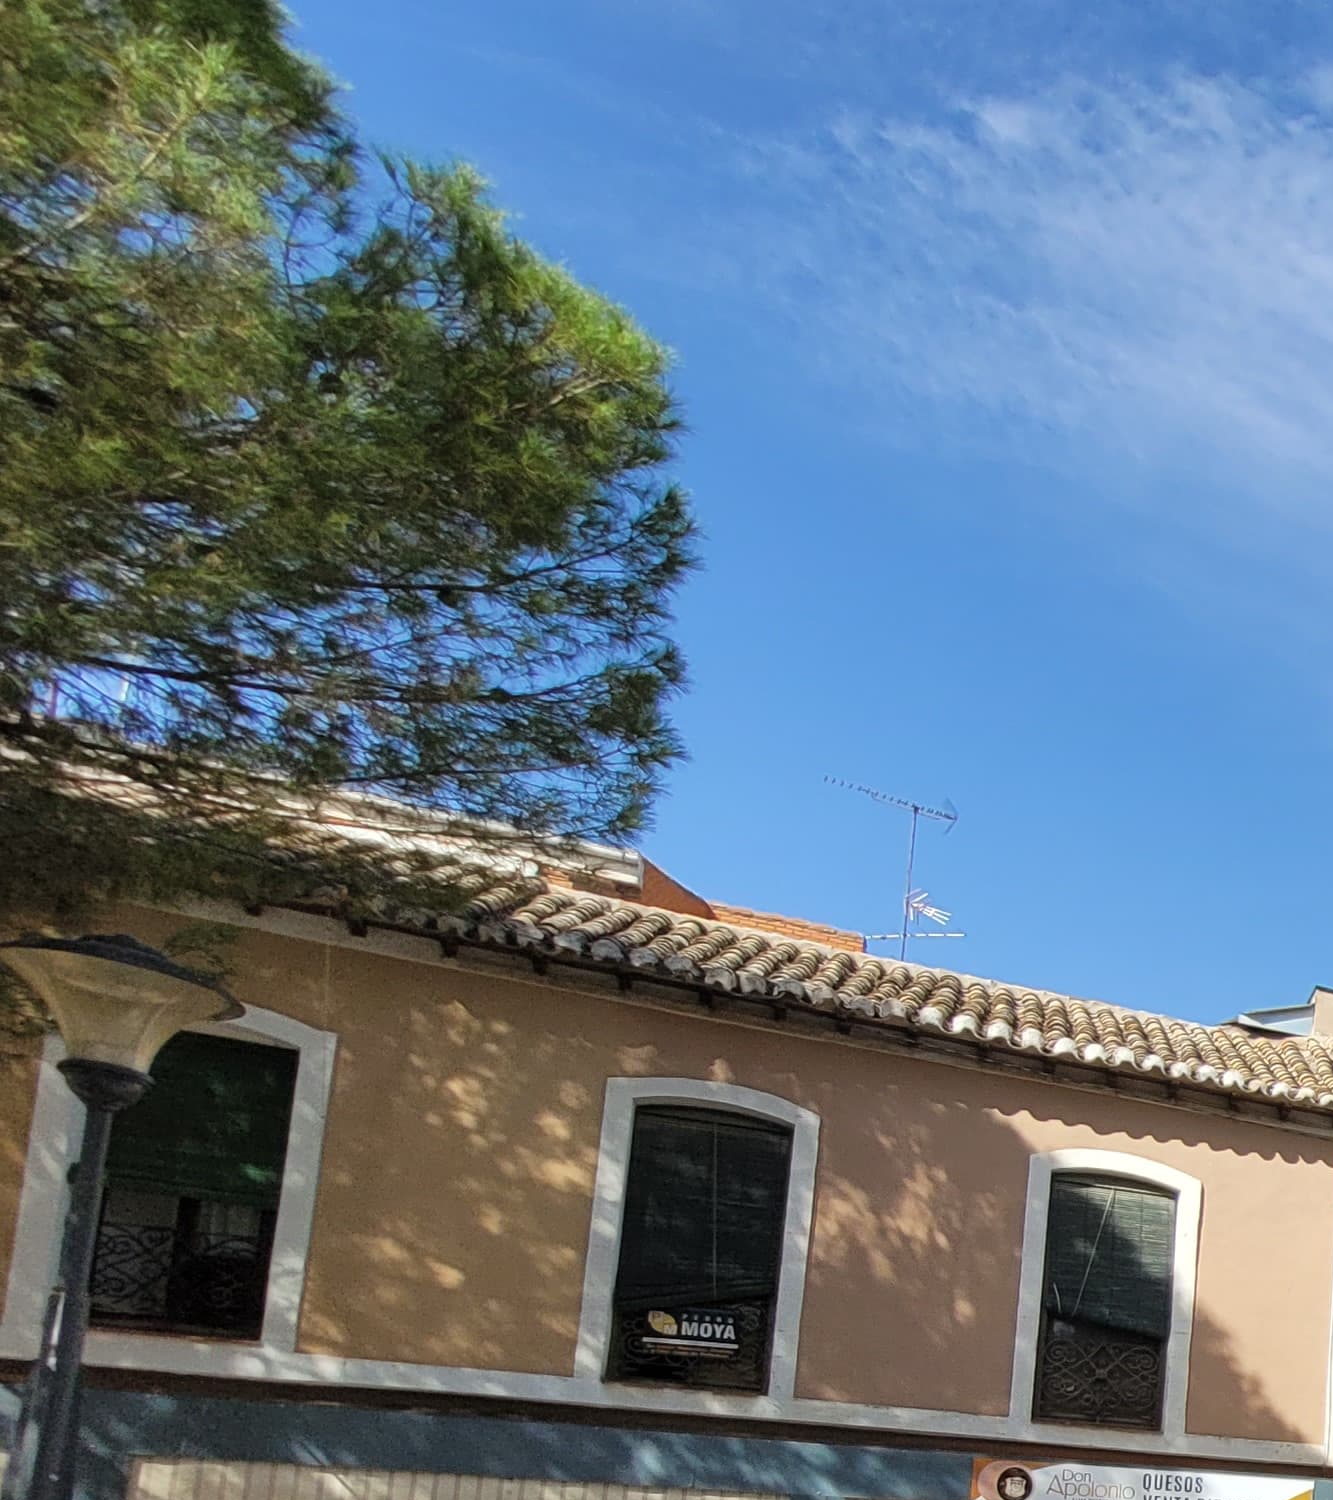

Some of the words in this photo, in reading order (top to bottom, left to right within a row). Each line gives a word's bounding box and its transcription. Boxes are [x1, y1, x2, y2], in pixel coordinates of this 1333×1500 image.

[681, 1321, 736, 1340] MOYA
[1062, 1469, 1092, 1483] Don
[1143, 1473, 1203, 1493] QUESOS
[1046, 1474, 1136, 1500] Apolonio
